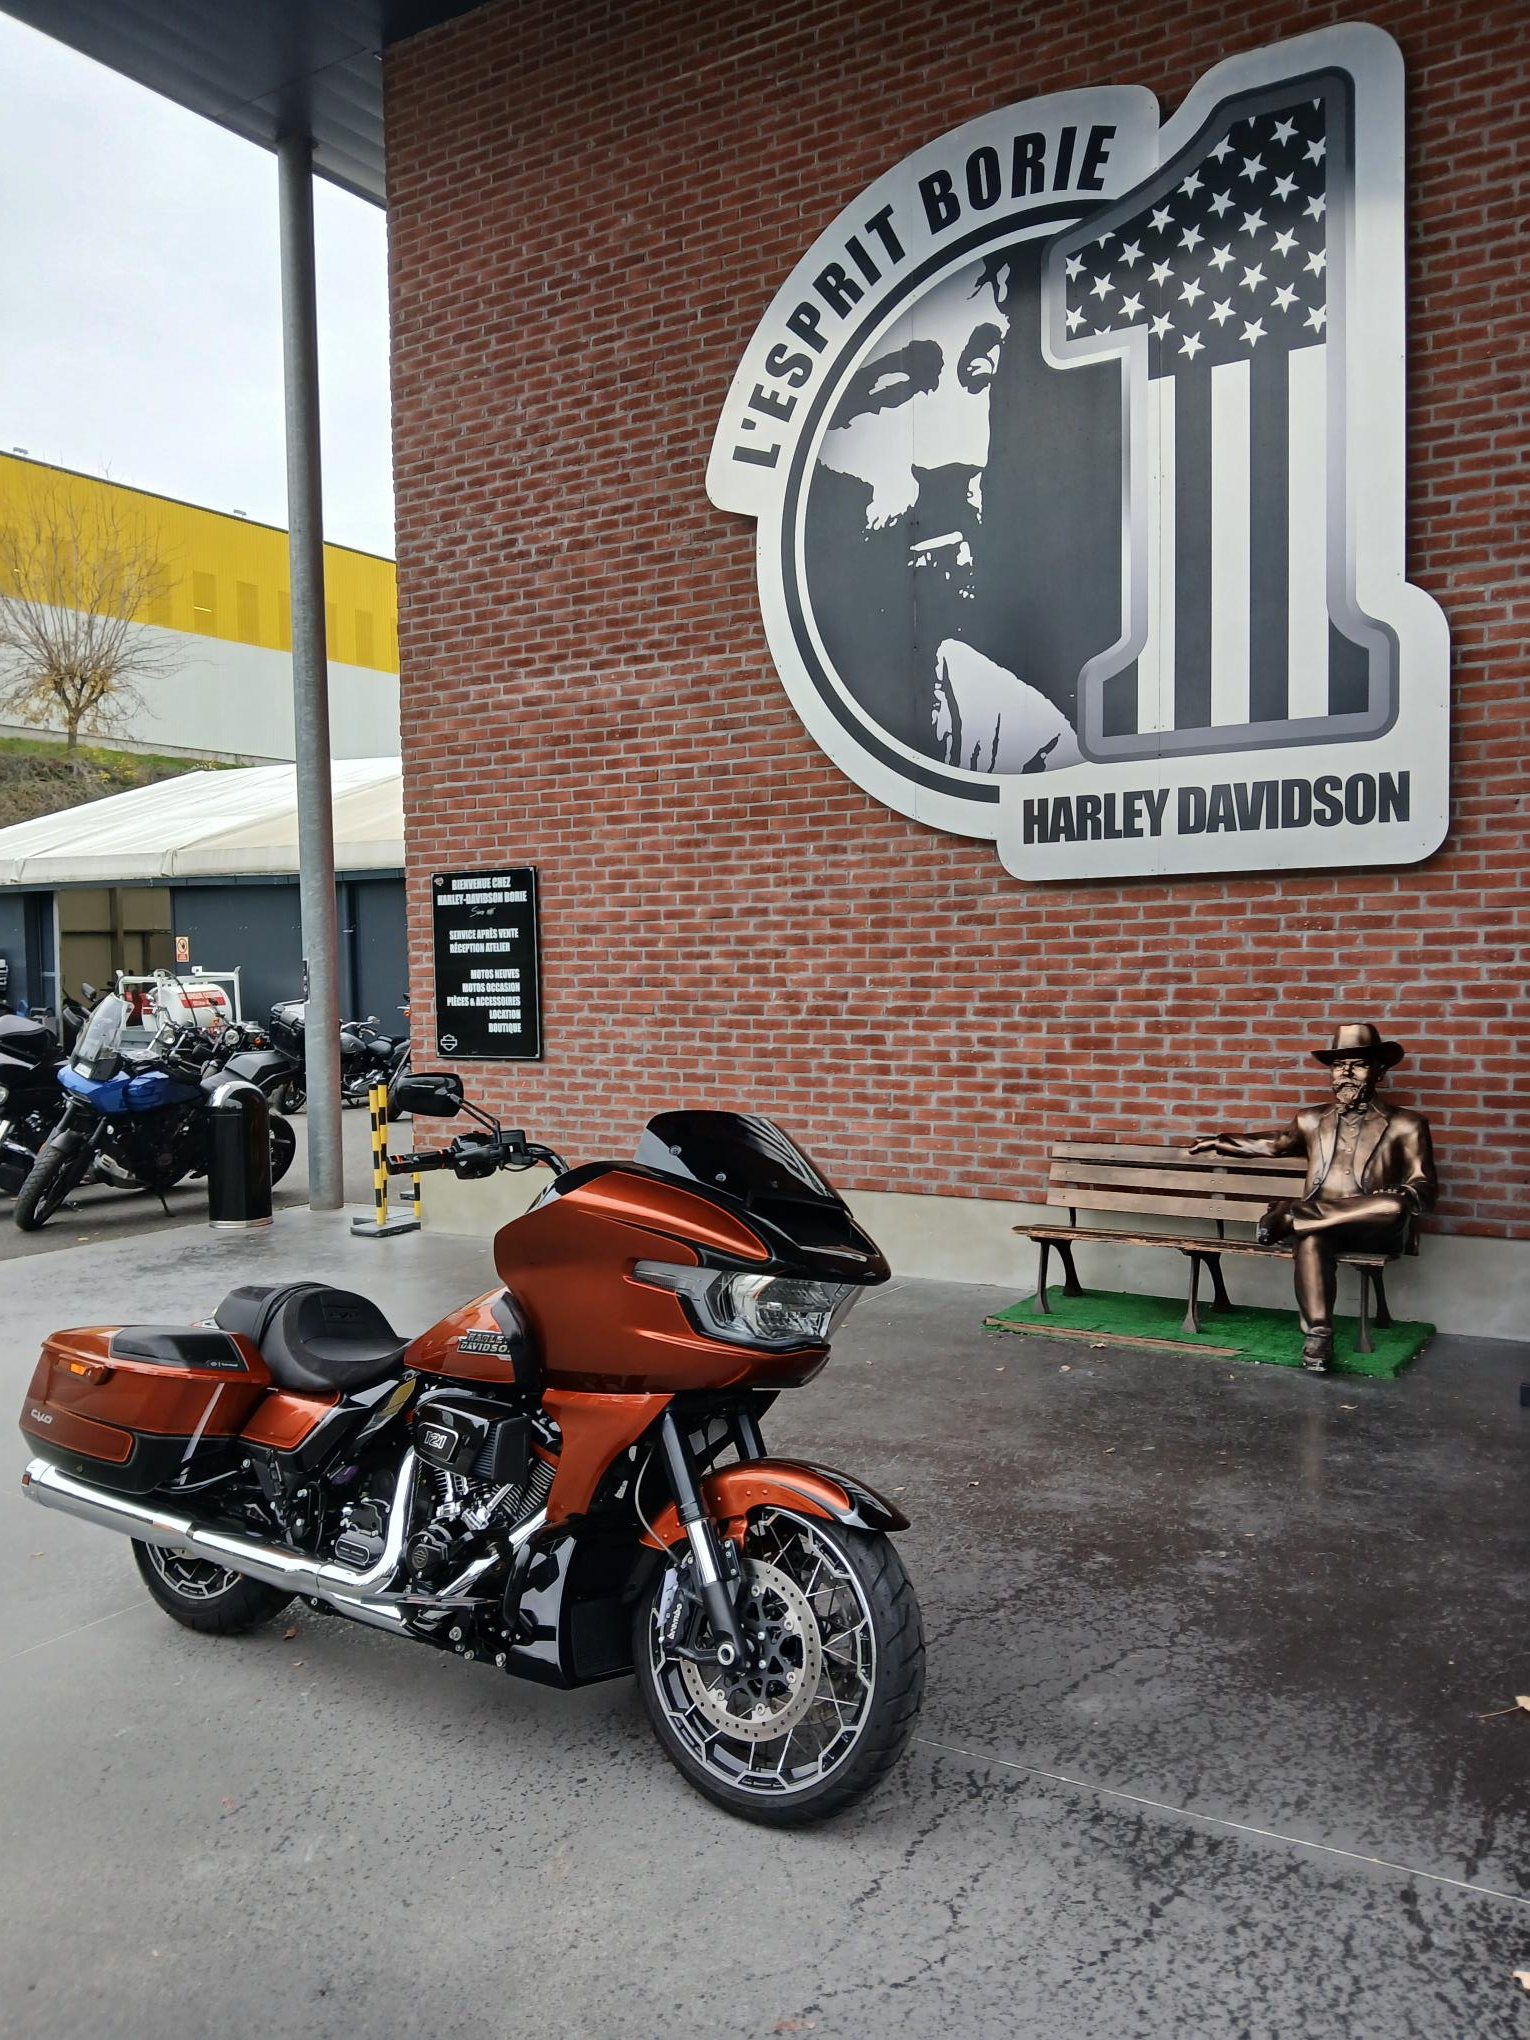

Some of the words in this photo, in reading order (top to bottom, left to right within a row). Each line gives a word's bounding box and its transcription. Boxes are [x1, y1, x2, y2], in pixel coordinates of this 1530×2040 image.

[732, 206, 913, 470] L'ESPRIT
[917, 125, 1117, 237] BORIE
[1022, 788, 1170, 845] HARLEY
[1177, 771, 1411, 834] DAVIDSON
[452, 878, 491, 890] BIENVENUE
[492, 876, 511, 888] CHEZ
[437, 892, 503, 906] HARLEY-DAVIDSON
[504, 890, 527, 902] BORIE
[449, 929, 476, 940] SERVICE
[477, 927, 498, 939] APRÈS
[498, 928, 519, 938] VENTE
[450, 942, 484, 953] RÉCEPTION
[485, 942, 510, 952] ATELIER
[470, 969, 494, 979] MOTOS
[494, 968, 520, 979] NEUVES
[462, 983, 485, 993] MOTOS
[486, 982, 520, 992] OCCASION
[447, 995, 469, 1006] PIÈCES
[470, 997, 475, 1006] &
[476, 996, 521, 1006] ACCESSOIRES
[489, 1009, 521, 1019] LOCATION
[488, 1023, 522, 1033] BOUTIQUE
[468, 1333, 507, 1344] HARLE
[460, 1341, 510, 1353] DAVIDSO
[31, 1409, 53, 1424] CVO
[424, 1431, 447, 1449] 121
[667, 1603, 682, 1640] brembo
